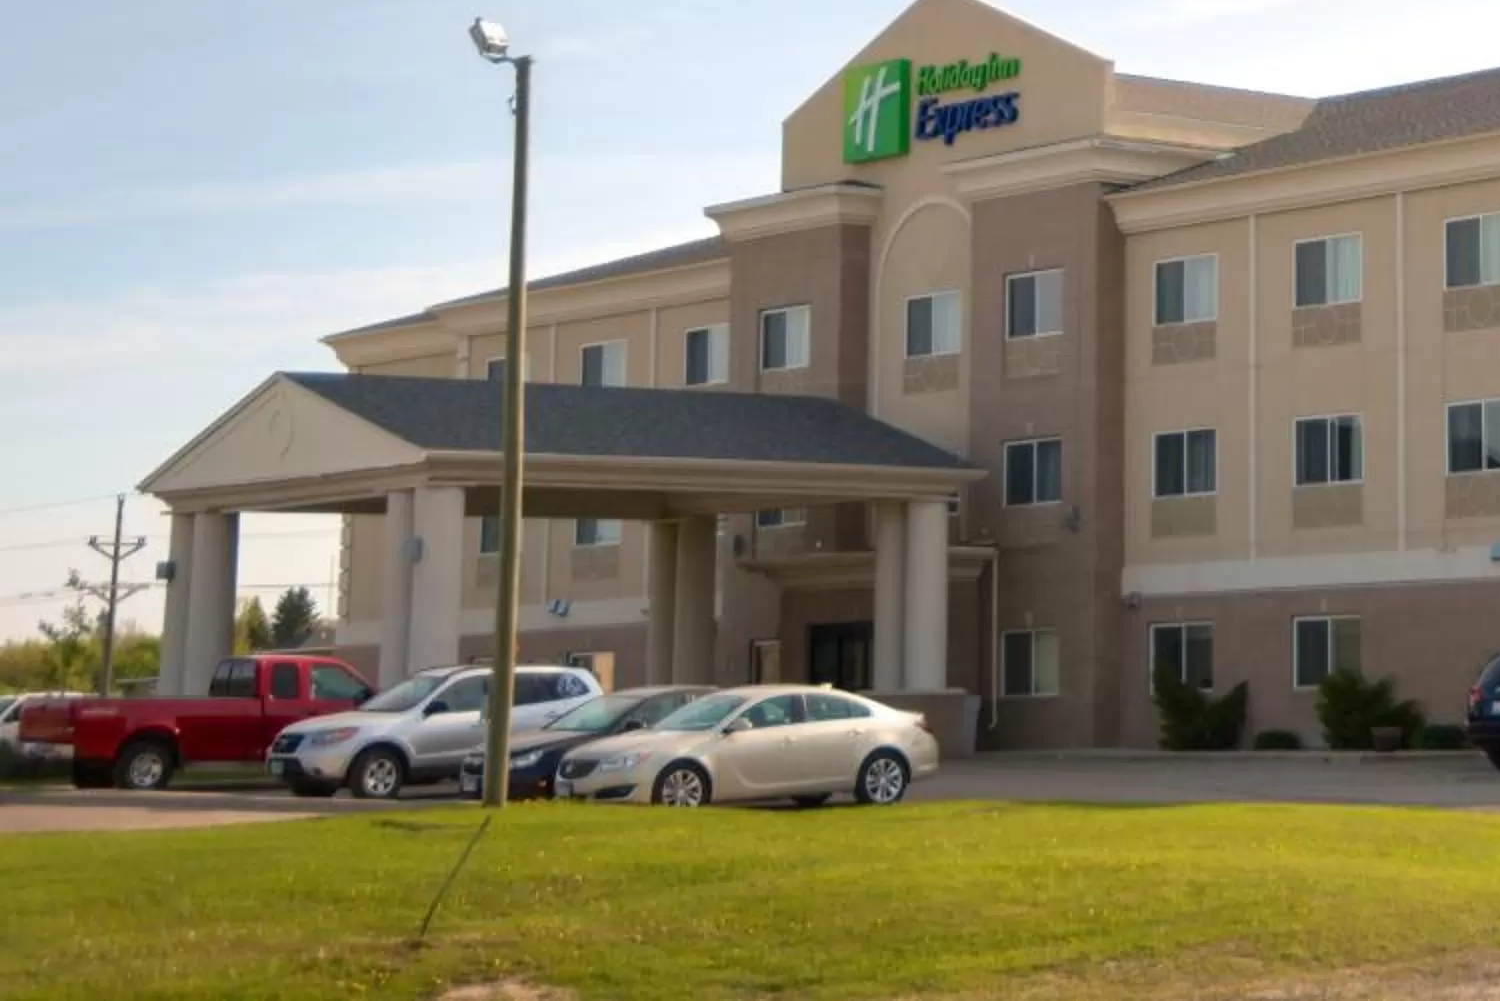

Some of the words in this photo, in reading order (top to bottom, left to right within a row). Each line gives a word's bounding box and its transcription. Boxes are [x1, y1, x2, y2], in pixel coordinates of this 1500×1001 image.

[917, 59, 988, 95] Holiday
[987, 52, 1021, 82] Inn
[914, 92, 1020, 147] Express
